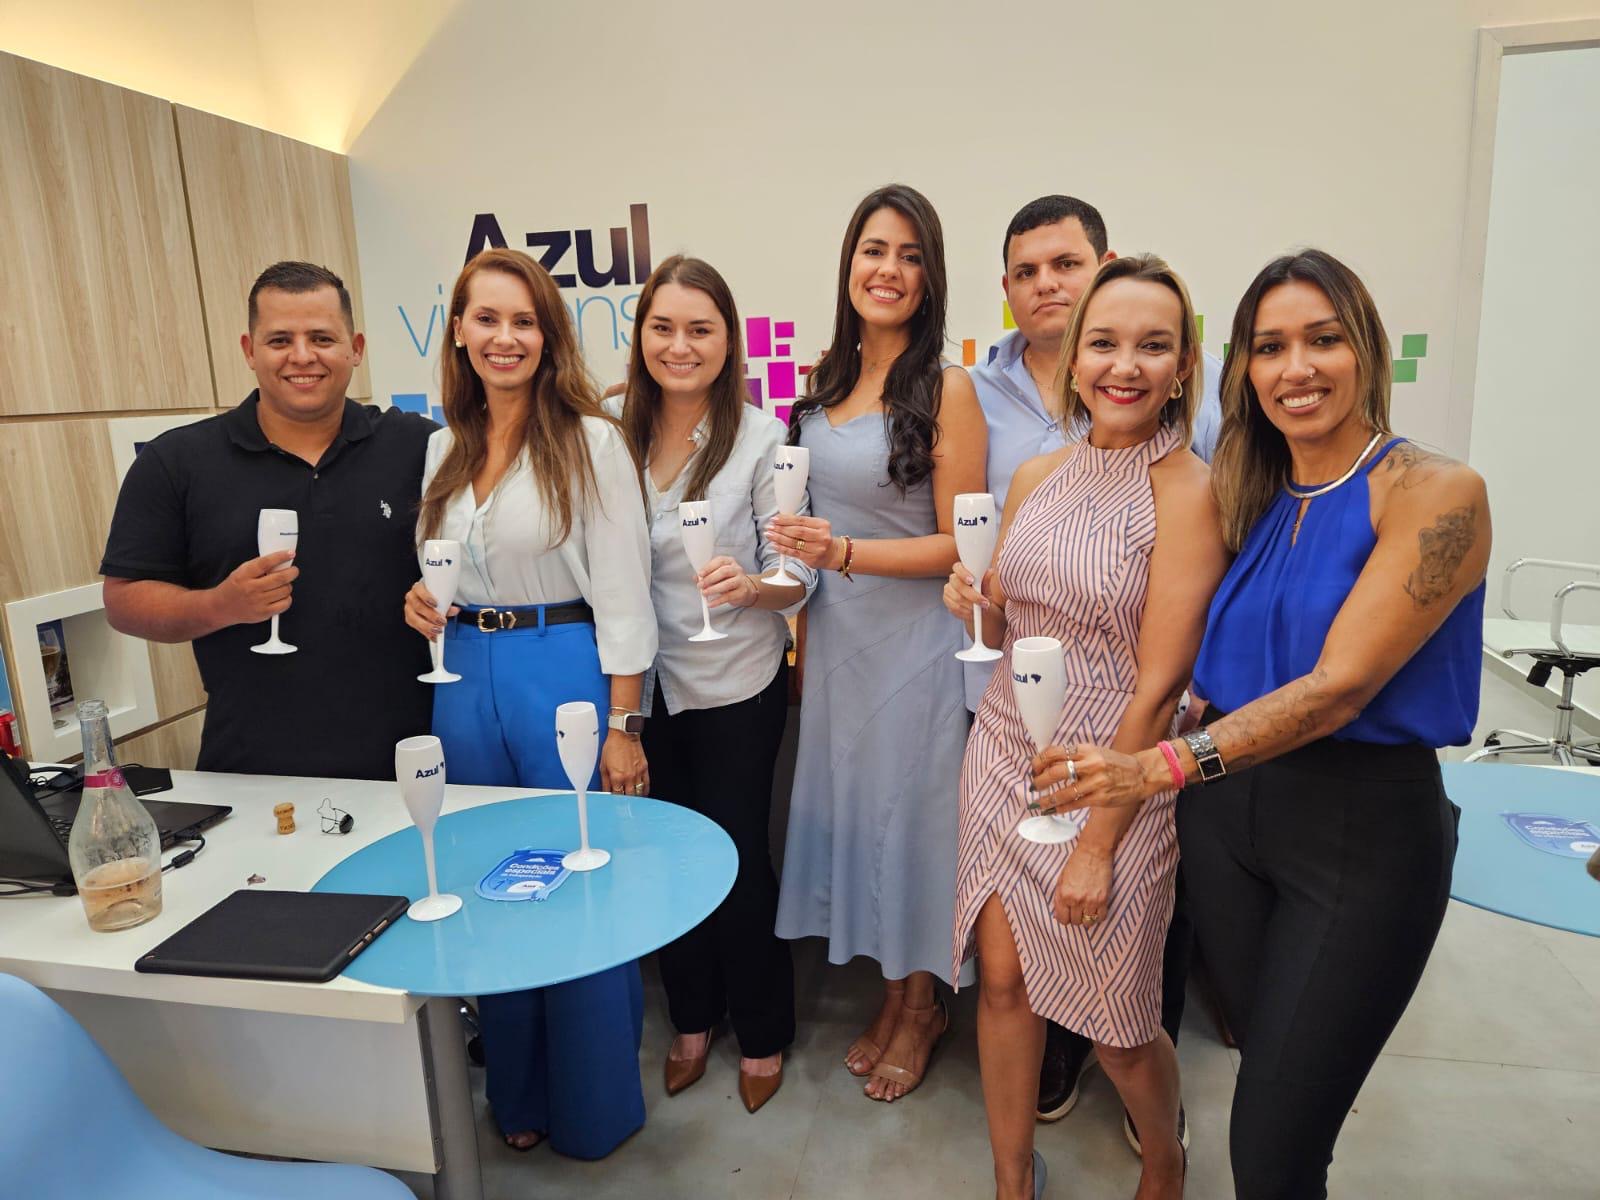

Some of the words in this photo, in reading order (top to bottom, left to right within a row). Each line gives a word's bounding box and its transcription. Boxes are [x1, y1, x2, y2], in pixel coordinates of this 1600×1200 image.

[463, 203, 651, 289] Azul
[397, 282, 641, 358] vins
[682, 517, 700, 526] Azul
[957, 516, 978, 526] Azul
[425, 557, 443, 567] Azul
[415, 764, 439, 779] Azul
